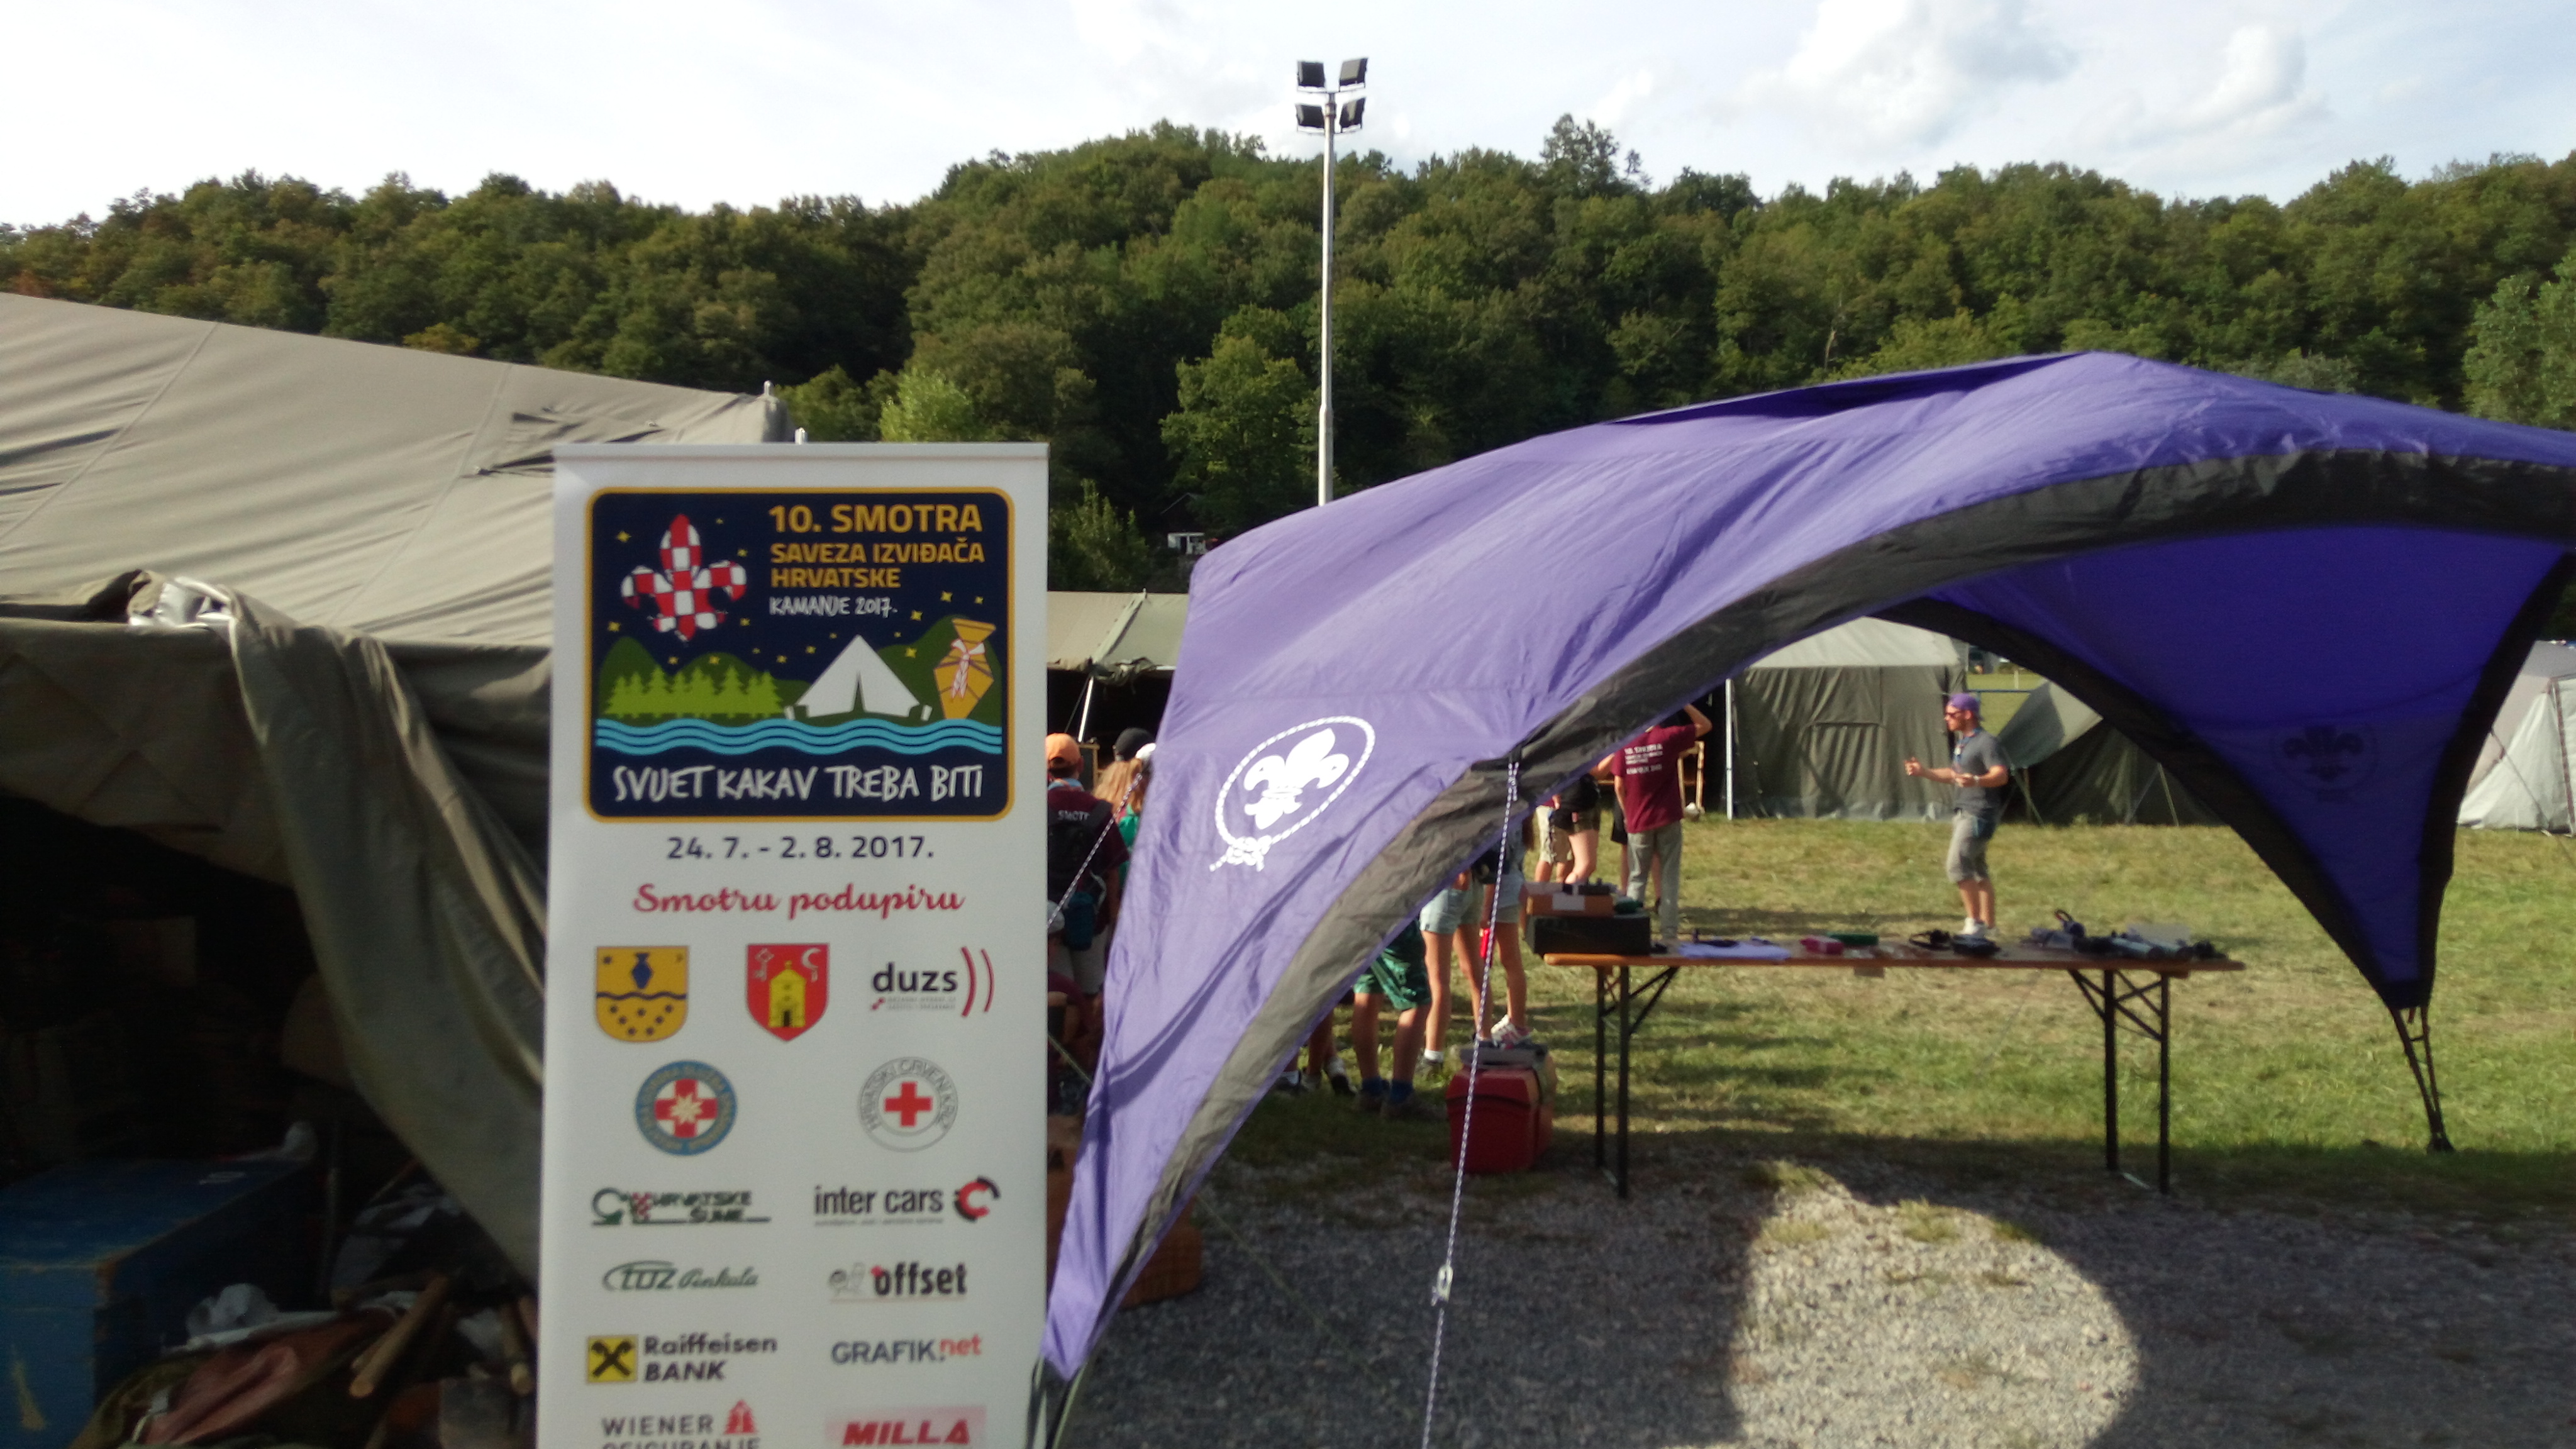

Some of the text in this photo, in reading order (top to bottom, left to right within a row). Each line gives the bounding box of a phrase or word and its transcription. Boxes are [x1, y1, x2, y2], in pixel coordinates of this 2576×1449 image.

[769, 503, 983, 533] 10. SMOTRA
[770, 536, 985, 564] SAVEZA IZVIĐAČA
[770, 567, 901, 588] HRVATSKE
[769, 595, 851, 617] KAMANJE
[716, 765, 818, 801] KAKAV
[824, 765, 921, 802] TREBA
[930, 765, 984, 802] BITI
[667, 836, 713, 859] 24.
[852, 835, 935, 858] 2017.
[633, 882, 966, 921] Smotru podupiru
[872, 962, 959, 992] duzs
[814, 1185, 945, 1214] inter cars
[872, 1262, 967, 1296] offset
[643, 1331, 779, 1355] Raiffeisen
[644, 1360, 727, 1382] BANK
[601, 1414, 714, 1436] WIENER
[843, 1419, 970, 1446] MILLA
